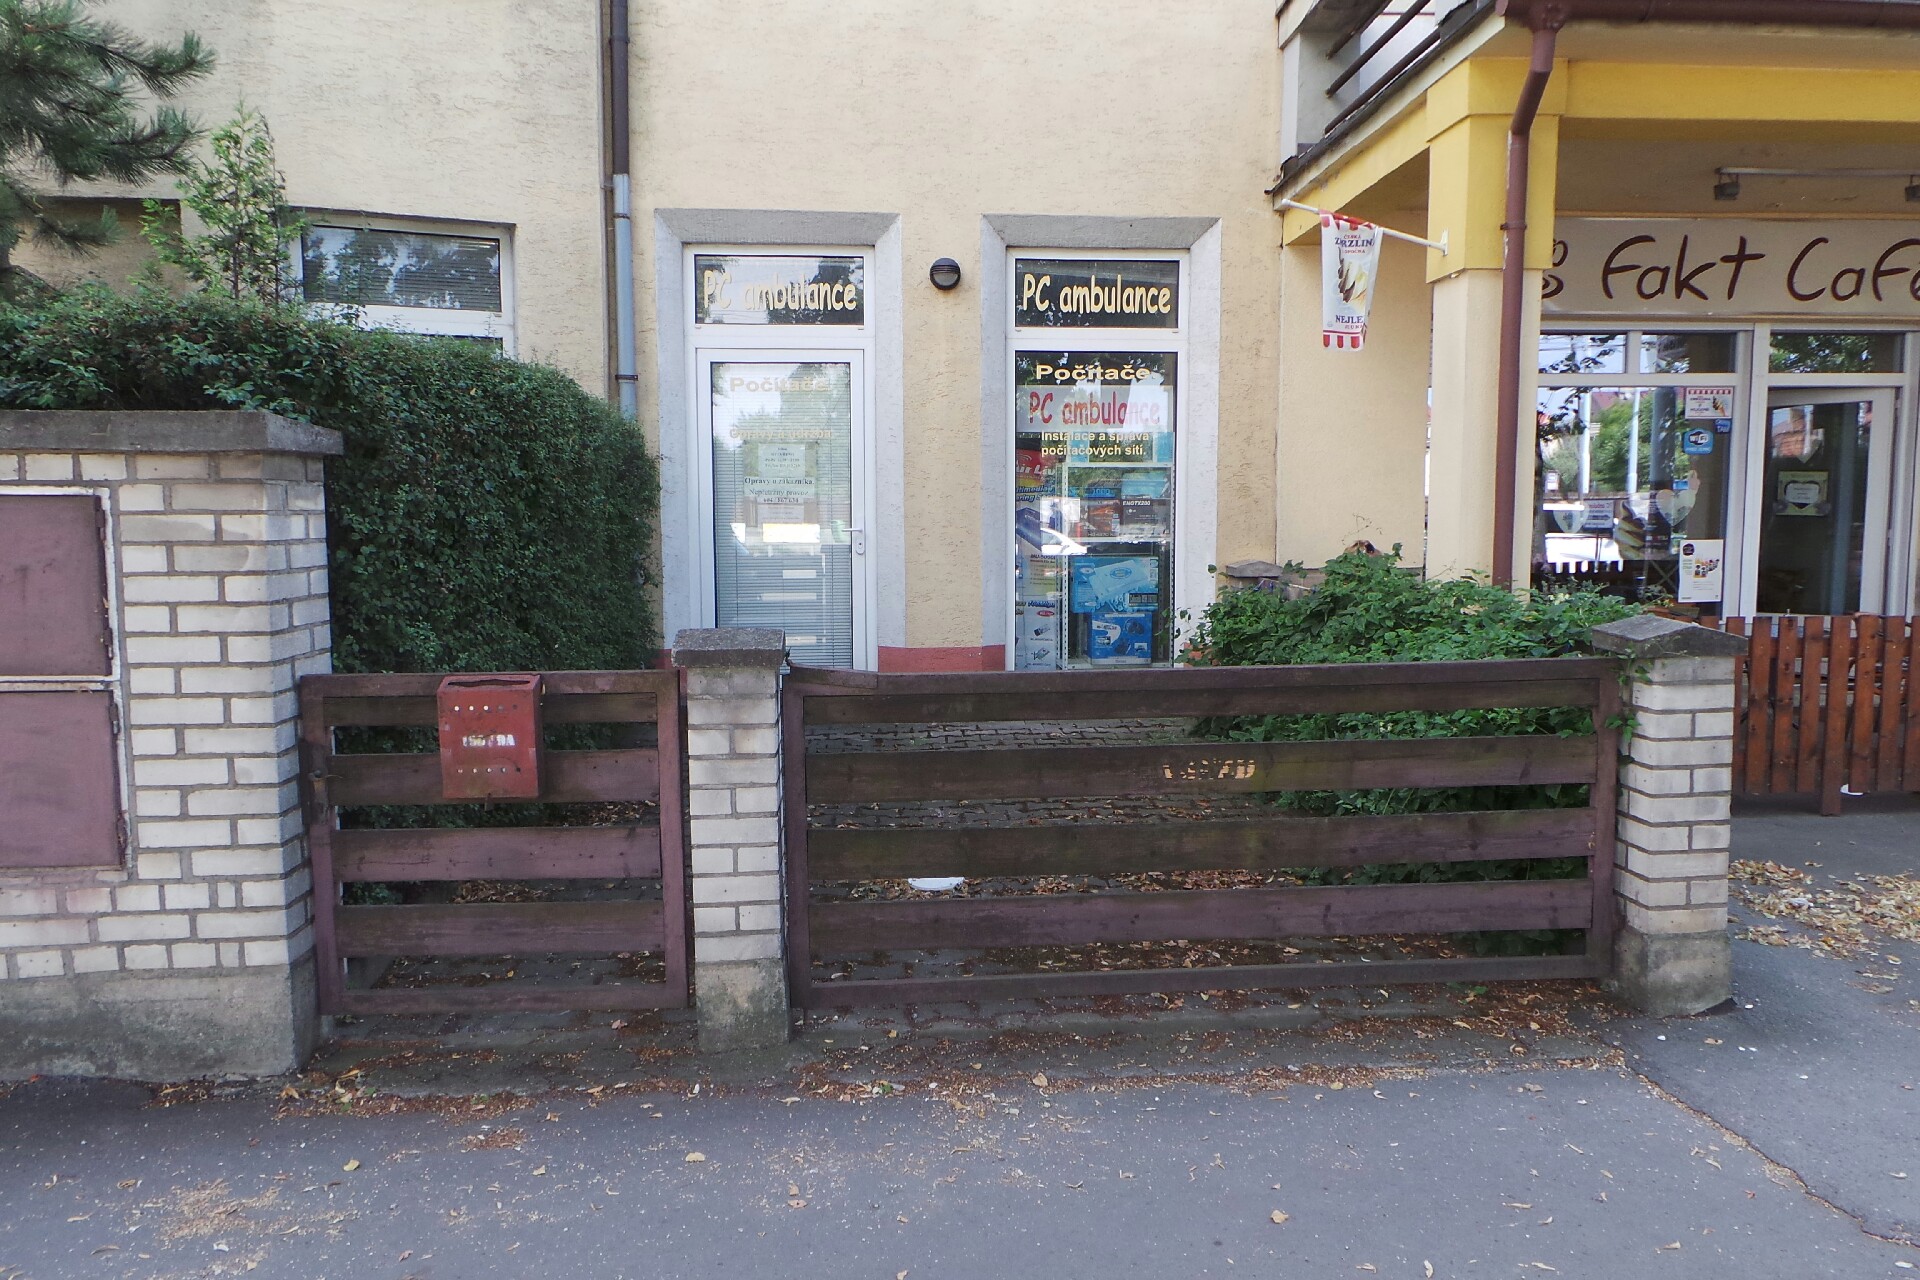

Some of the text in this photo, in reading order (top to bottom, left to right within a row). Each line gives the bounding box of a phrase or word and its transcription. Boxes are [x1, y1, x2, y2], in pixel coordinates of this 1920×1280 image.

[1601, 234, 1766, 301] Fakt
[704, 269, 857, 311] PC ambulance
[1023, 273, 1171, 314] PC ambulance
[1036, 364, 1151, 381] Počítače
[1029, 391, 1160, 426] PC ambulance
[1041, 432, 1150, 445] Instalace a správa
[1041, 444, 1122, 458] počítačových
